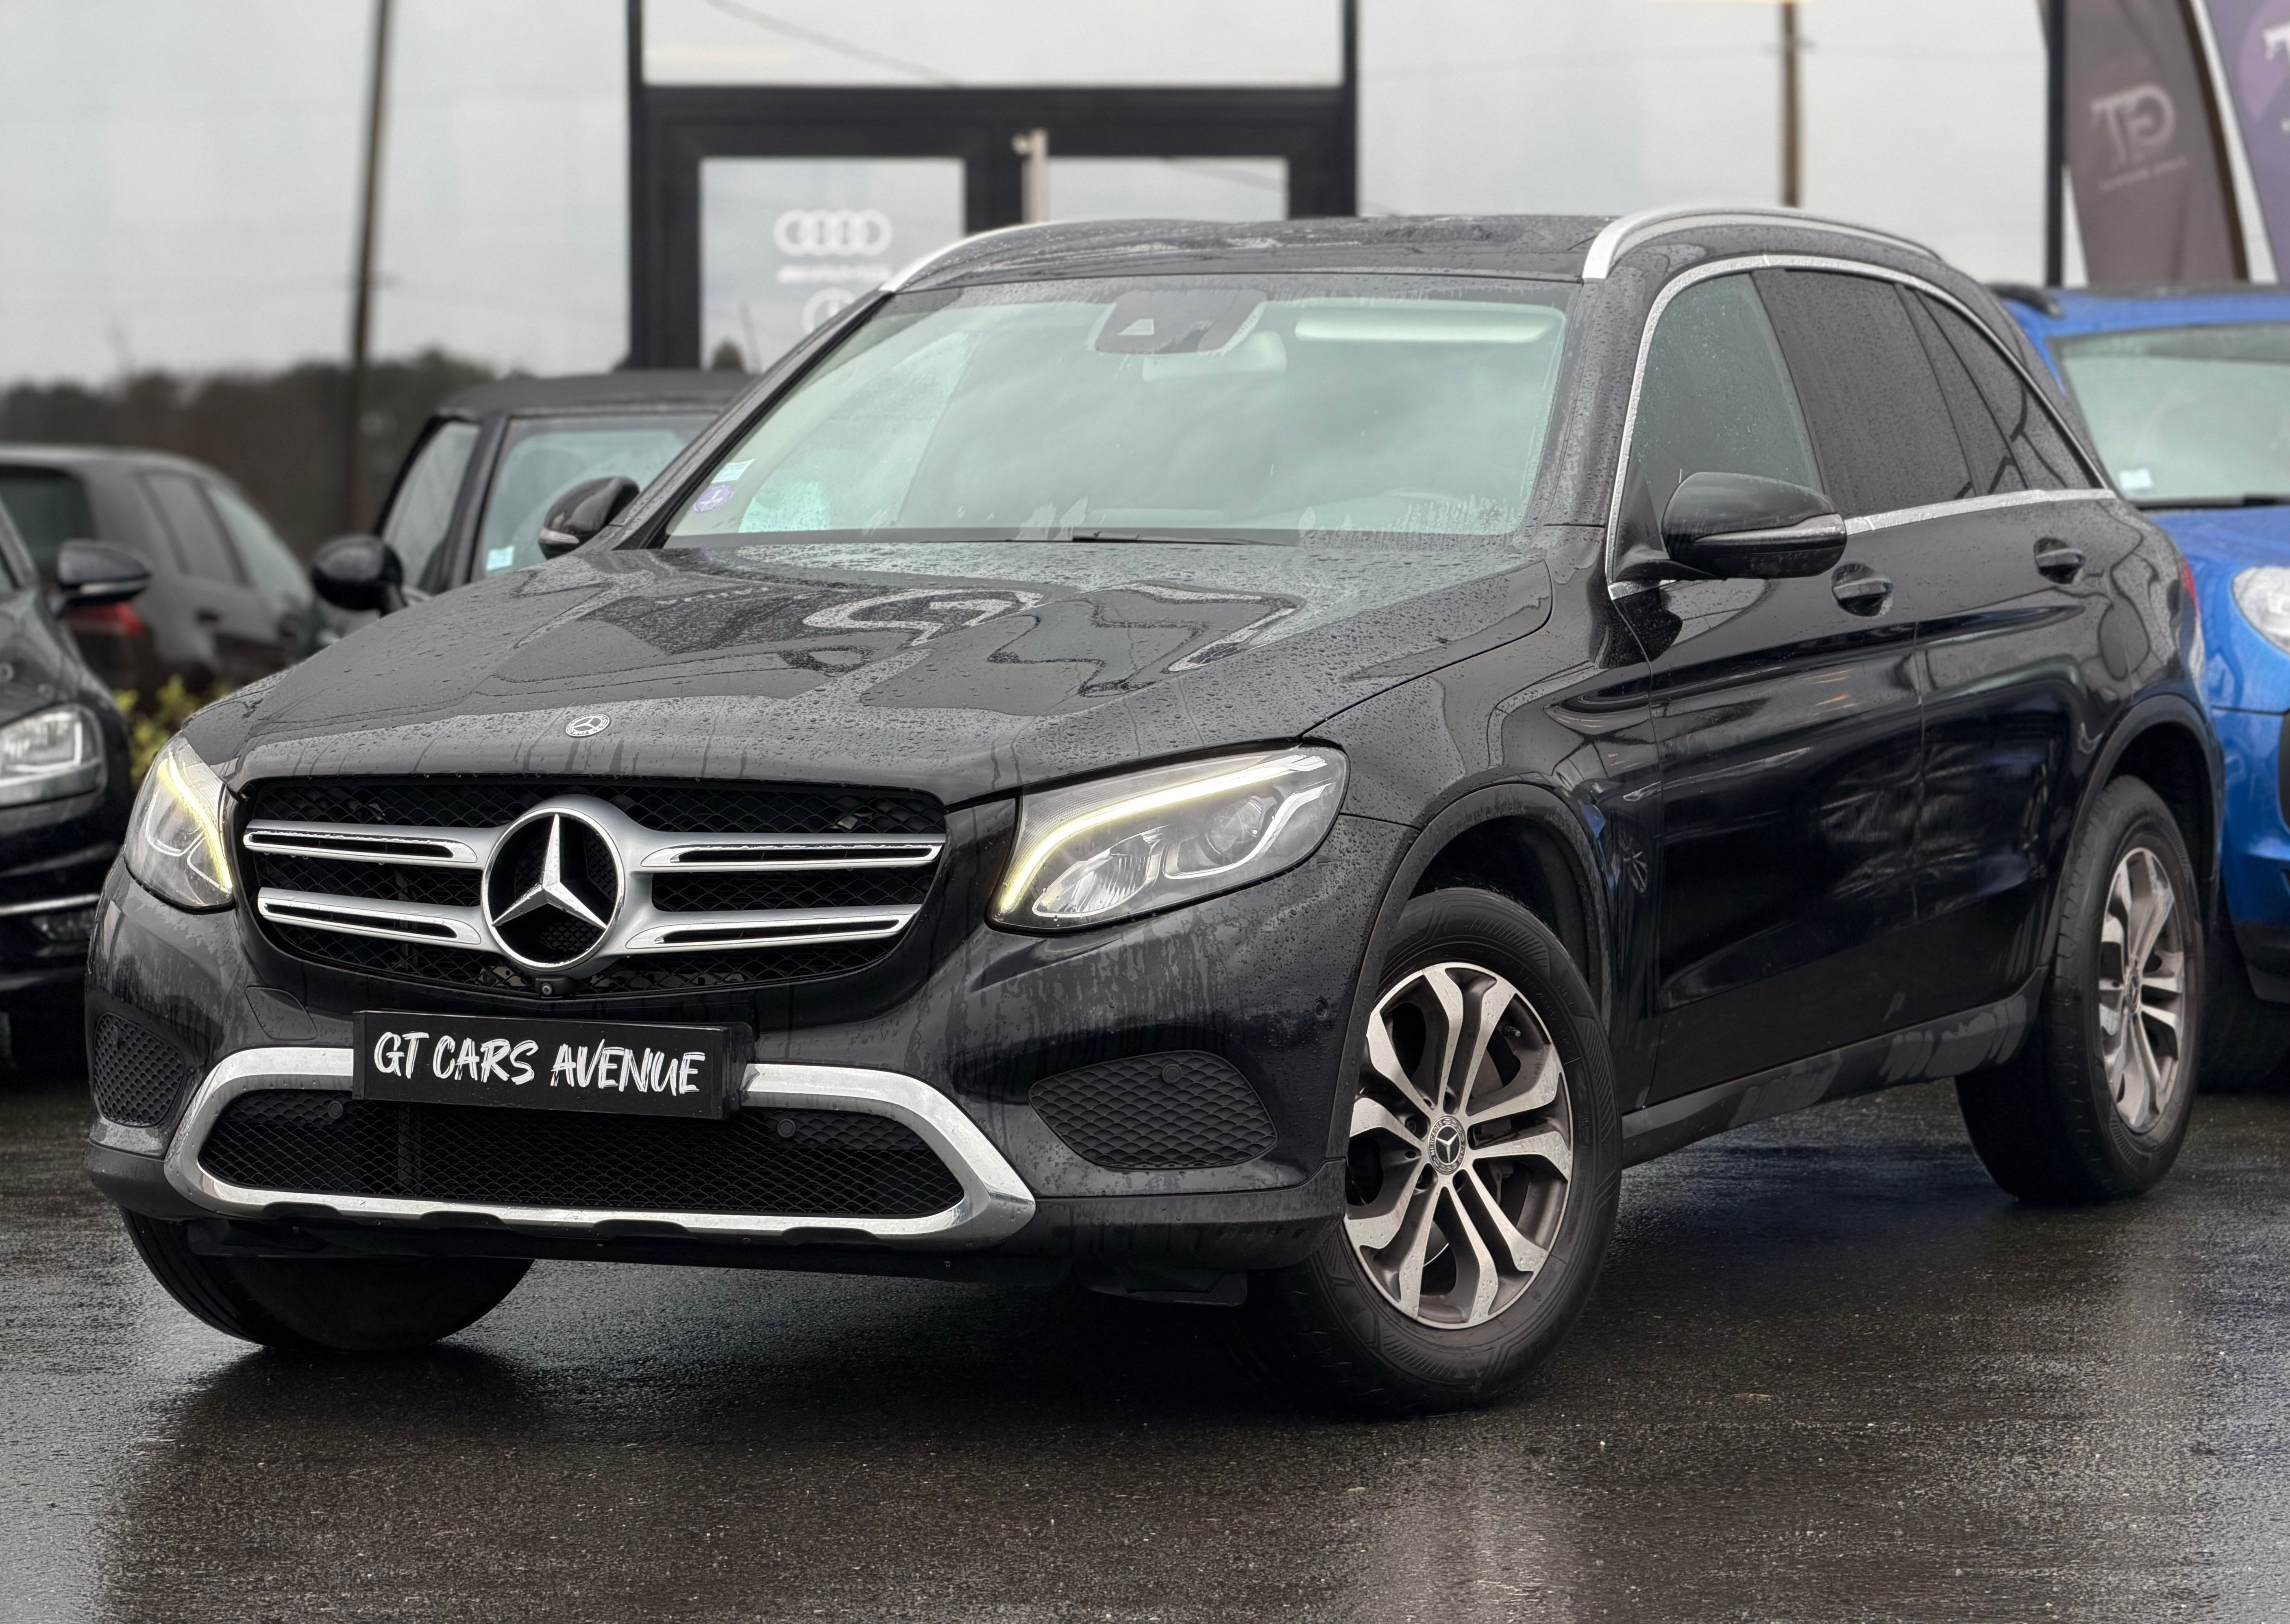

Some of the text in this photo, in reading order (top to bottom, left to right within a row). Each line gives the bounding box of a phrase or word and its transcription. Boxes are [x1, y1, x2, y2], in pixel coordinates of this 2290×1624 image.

[374, 1032, 705, 1096] GT CARS AVENUE
